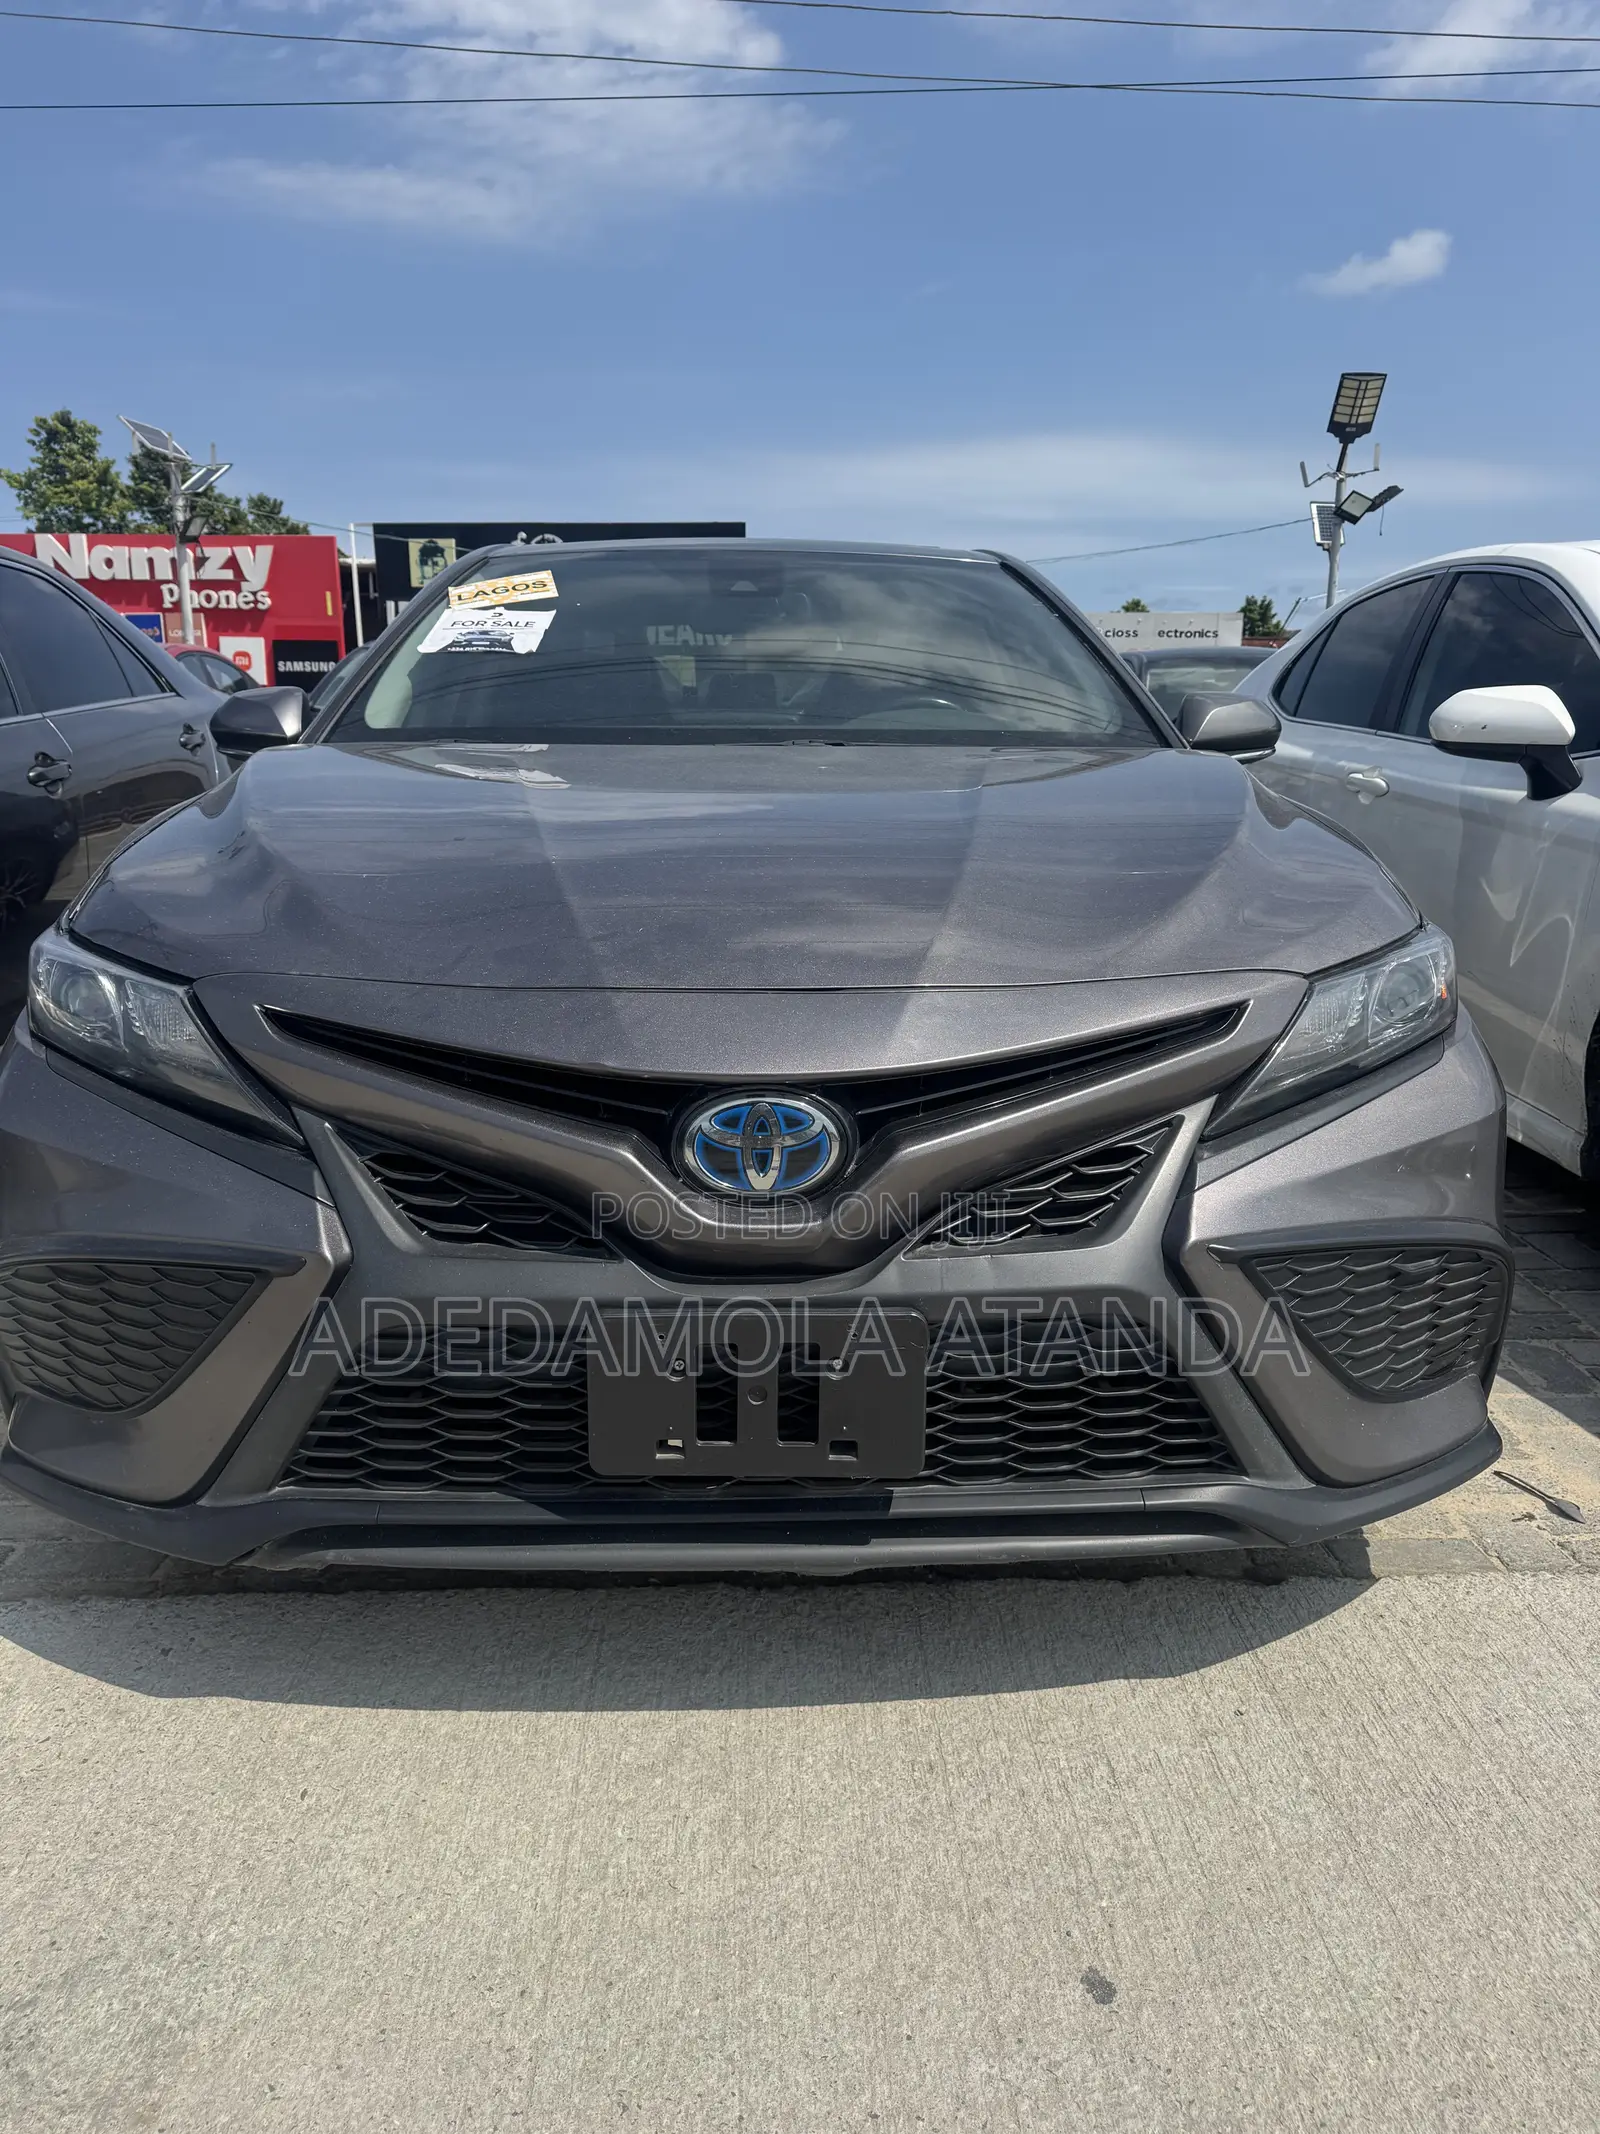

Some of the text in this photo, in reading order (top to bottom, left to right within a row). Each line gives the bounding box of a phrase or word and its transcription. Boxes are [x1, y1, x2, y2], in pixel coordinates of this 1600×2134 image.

[34, 533, 274, 592] Namzy
[457, 580, 548, 601] LAGOS
[450, 620, 536, 628] FOR SALE
